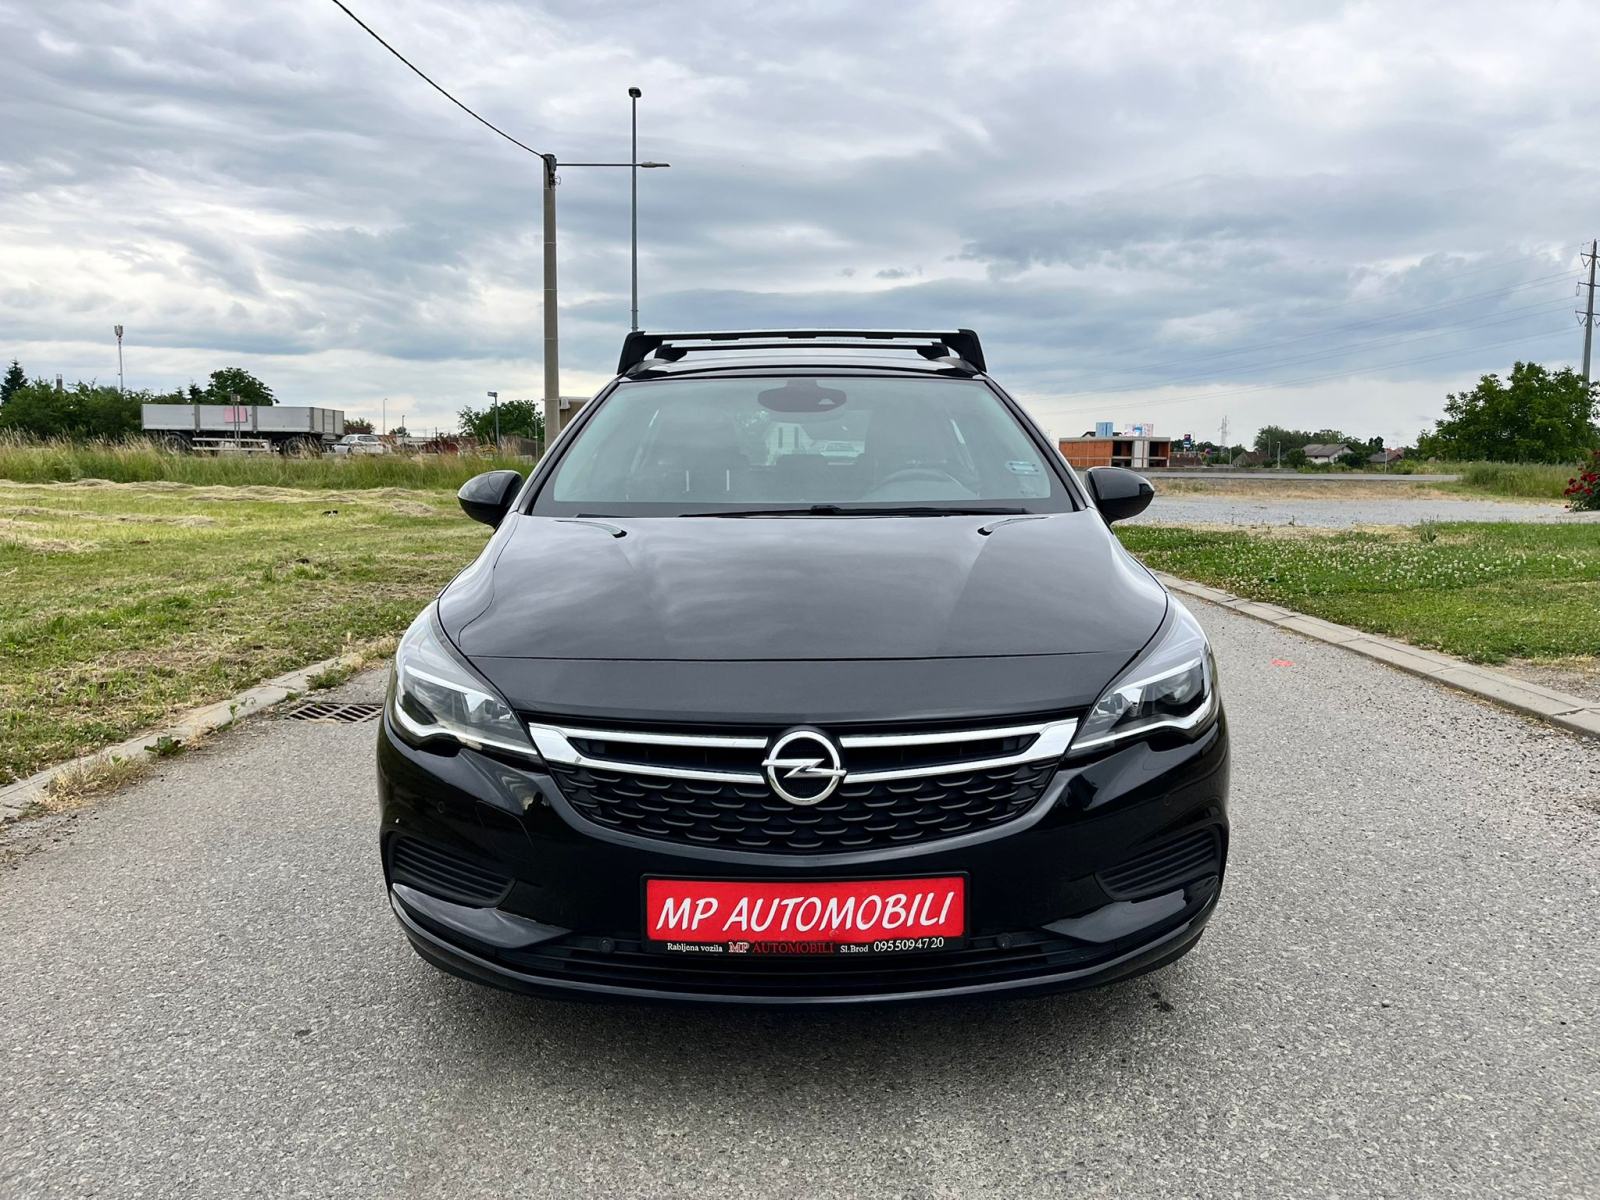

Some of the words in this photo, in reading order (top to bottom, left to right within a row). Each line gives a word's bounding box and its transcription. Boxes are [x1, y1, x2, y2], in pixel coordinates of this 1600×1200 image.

[656, 897, 718, 931] MP
[722, 891, 955, 932] AUTOMOBILI
[667, 942, 699, 953] Rabljena
[700, 943, 723, 952] vozila
[728, 941, 750, 953] MP
[752, 942, 835, 954] AUTOMOBILI
